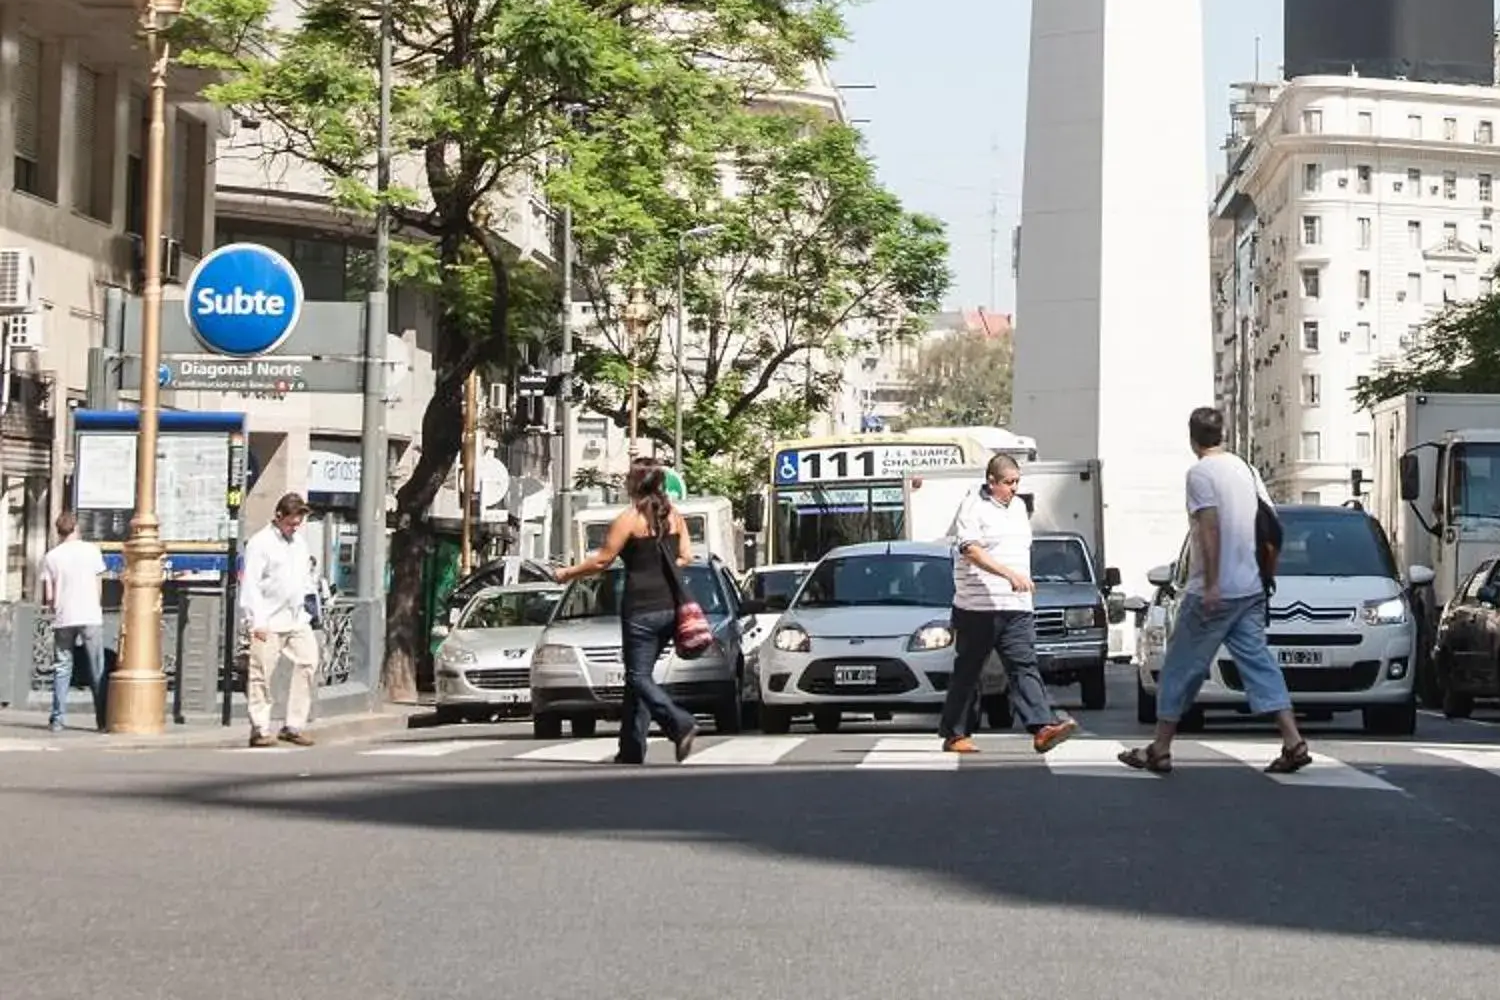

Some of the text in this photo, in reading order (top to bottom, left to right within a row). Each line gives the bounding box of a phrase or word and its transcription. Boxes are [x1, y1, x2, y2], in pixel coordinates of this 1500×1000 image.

[197, 286, 285, 316] Subte
[181, 362, 302, 378] Diagonal Norte
[802, 451, 875, 479] 111
[882, 457, 959, 467] CHACARITA
